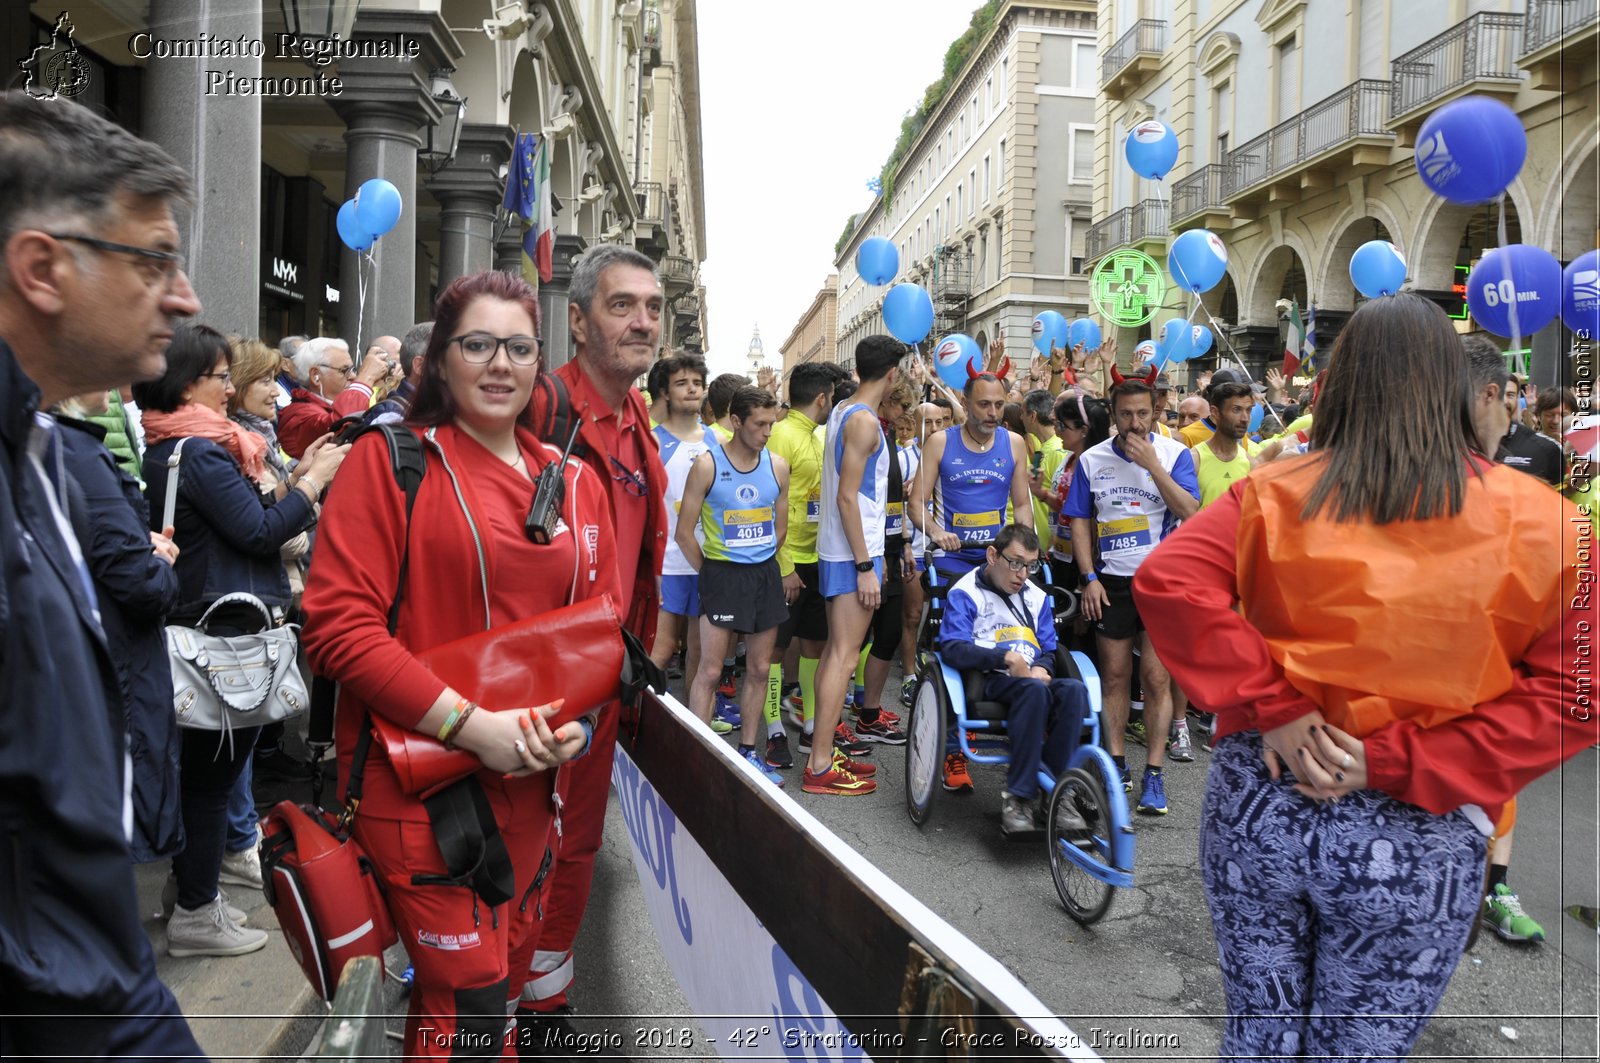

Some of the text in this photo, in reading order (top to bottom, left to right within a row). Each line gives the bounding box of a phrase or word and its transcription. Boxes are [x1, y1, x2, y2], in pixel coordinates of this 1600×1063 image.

[273, 256, 297, 285] NYX
[1483, 279, 1515, 307] 60
[1517, 291, 1541, 302] MIN.
[963, 469, 1006, 483] INTERFORZE
[1109, 486, 1161, 504] INTERFORZE
[737, 526, 764, 539] 4019
[963, 529, 991, 541] 7479
[1109, 536, 1138, 550] 7485
[1008, 643, 1036, 658] 7489
[768, 677, 779, 718] Kalenji
